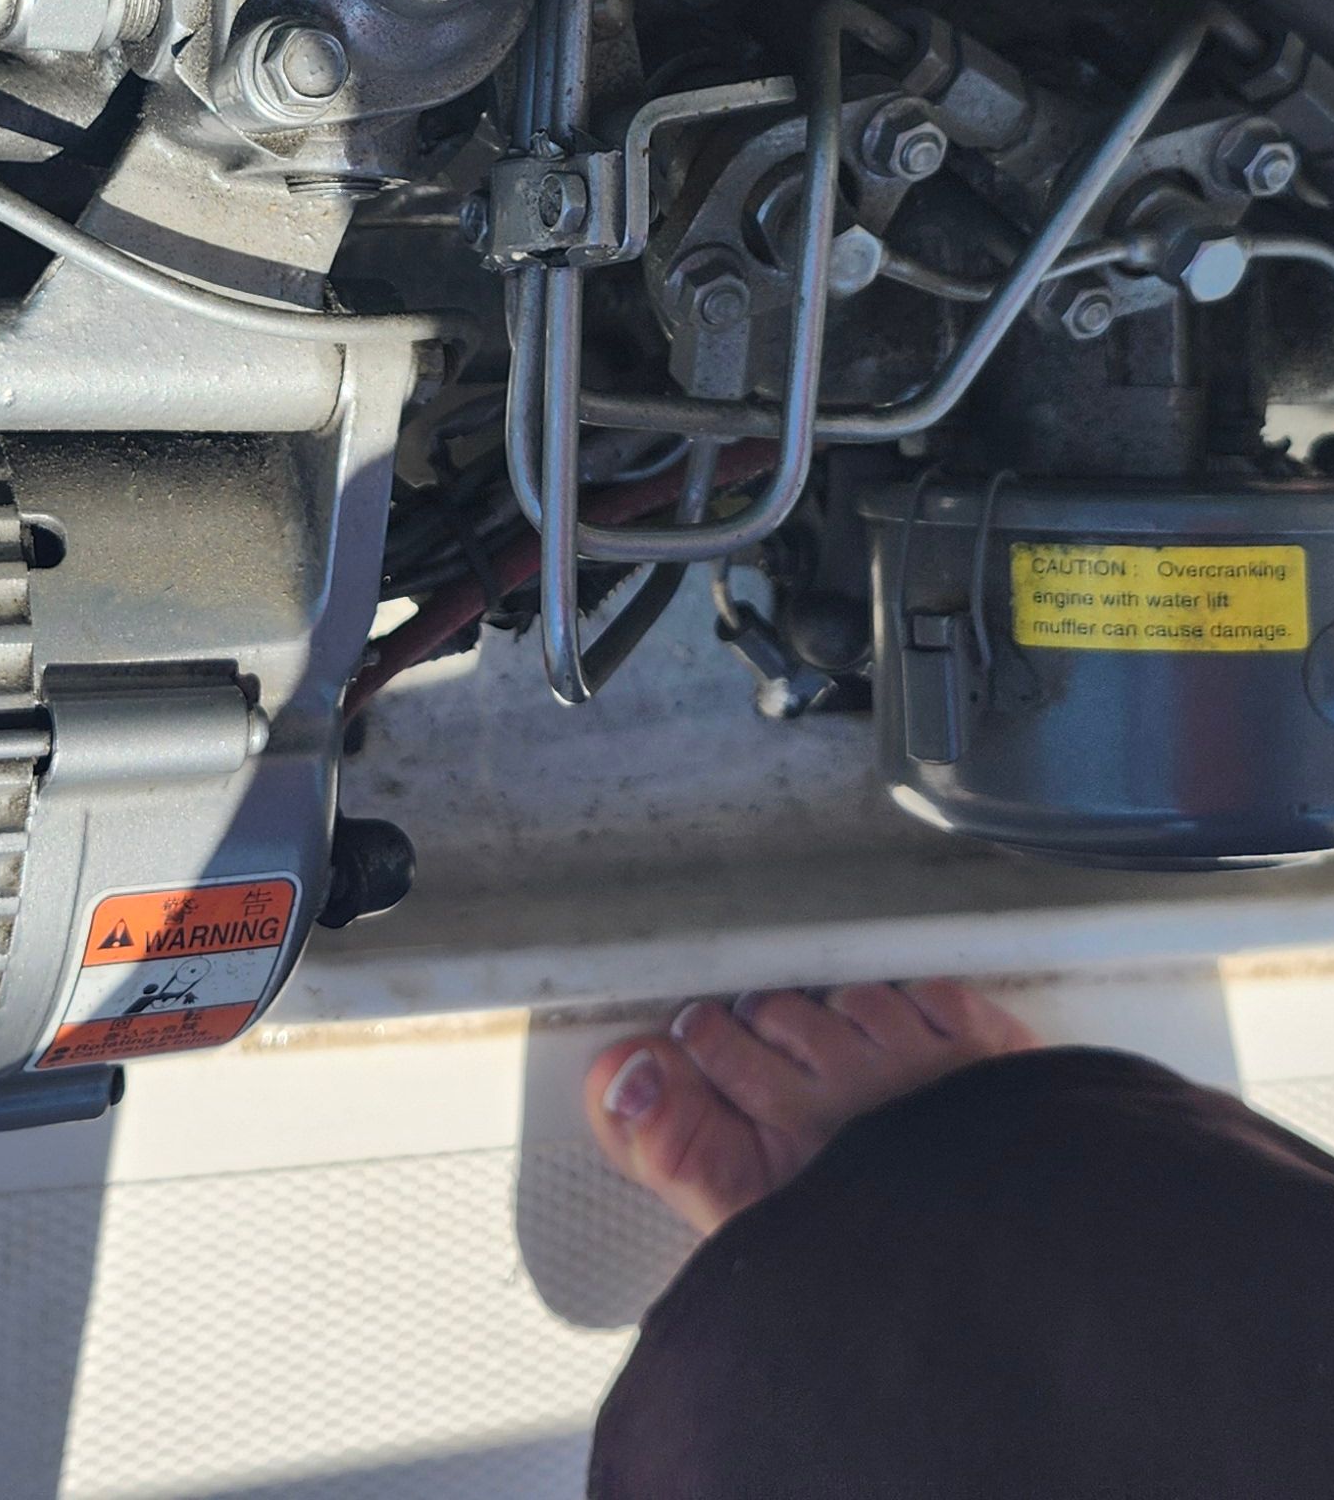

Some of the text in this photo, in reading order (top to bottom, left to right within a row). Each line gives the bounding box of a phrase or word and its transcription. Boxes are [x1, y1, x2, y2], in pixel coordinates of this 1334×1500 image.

[1031, 557, 1126, 577] CAUTION
[1157, 560, 1286, 580] Overcranking
[1033, 590, 1230, 608] engine with water lift
[1033, 618, 1292, 641] muffler can cause damage.
[145, 917, 280, 953] WARNING
[76, 1036, 152, 1051] Rotating
